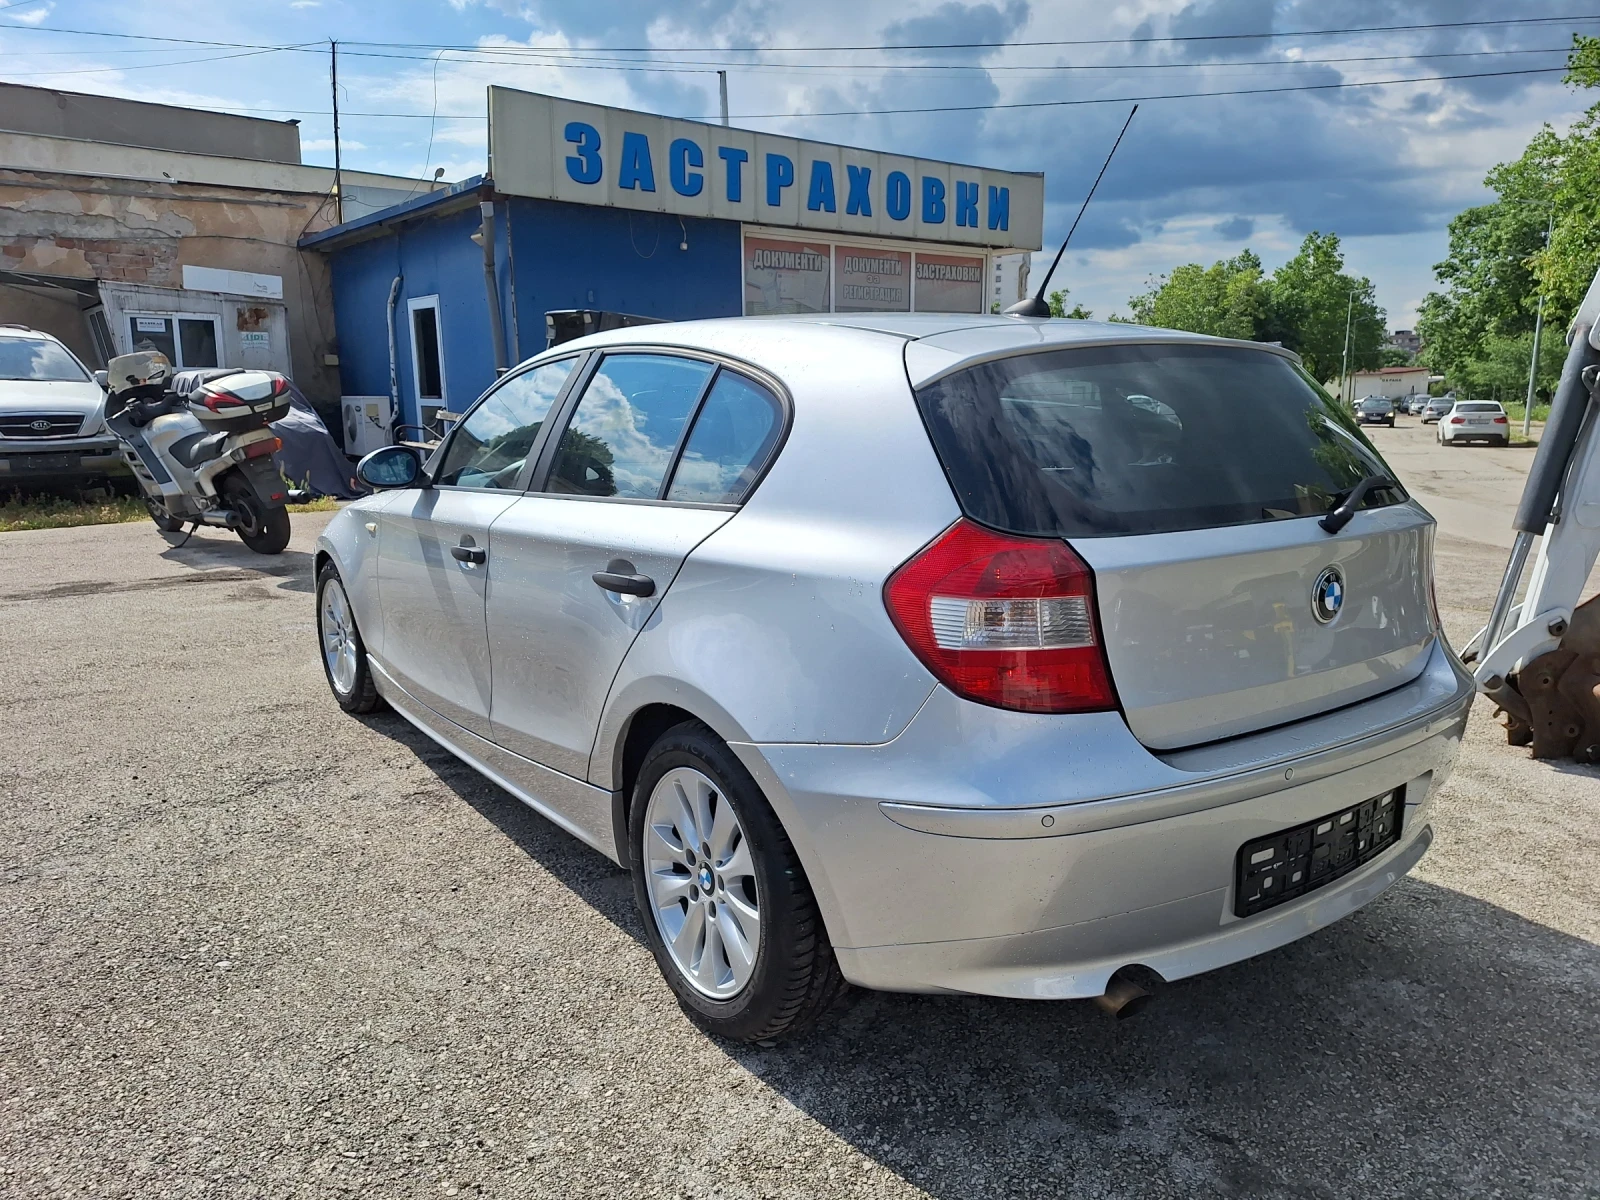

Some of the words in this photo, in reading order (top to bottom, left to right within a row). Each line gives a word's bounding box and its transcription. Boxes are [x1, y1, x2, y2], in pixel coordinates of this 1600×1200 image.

[564, 121, 1010, 231] ЗАСТРАХОВКИ
[753, 248, 823, 272] ДОКУМЕНТИ
[844, 256, 902, 276] ДОКУМЕНТИ
[916, 263, 981, 282] ЗАСТРАХОВКИ
[843, 284, 902, 303] РЕГИСТРАЦИЯ
